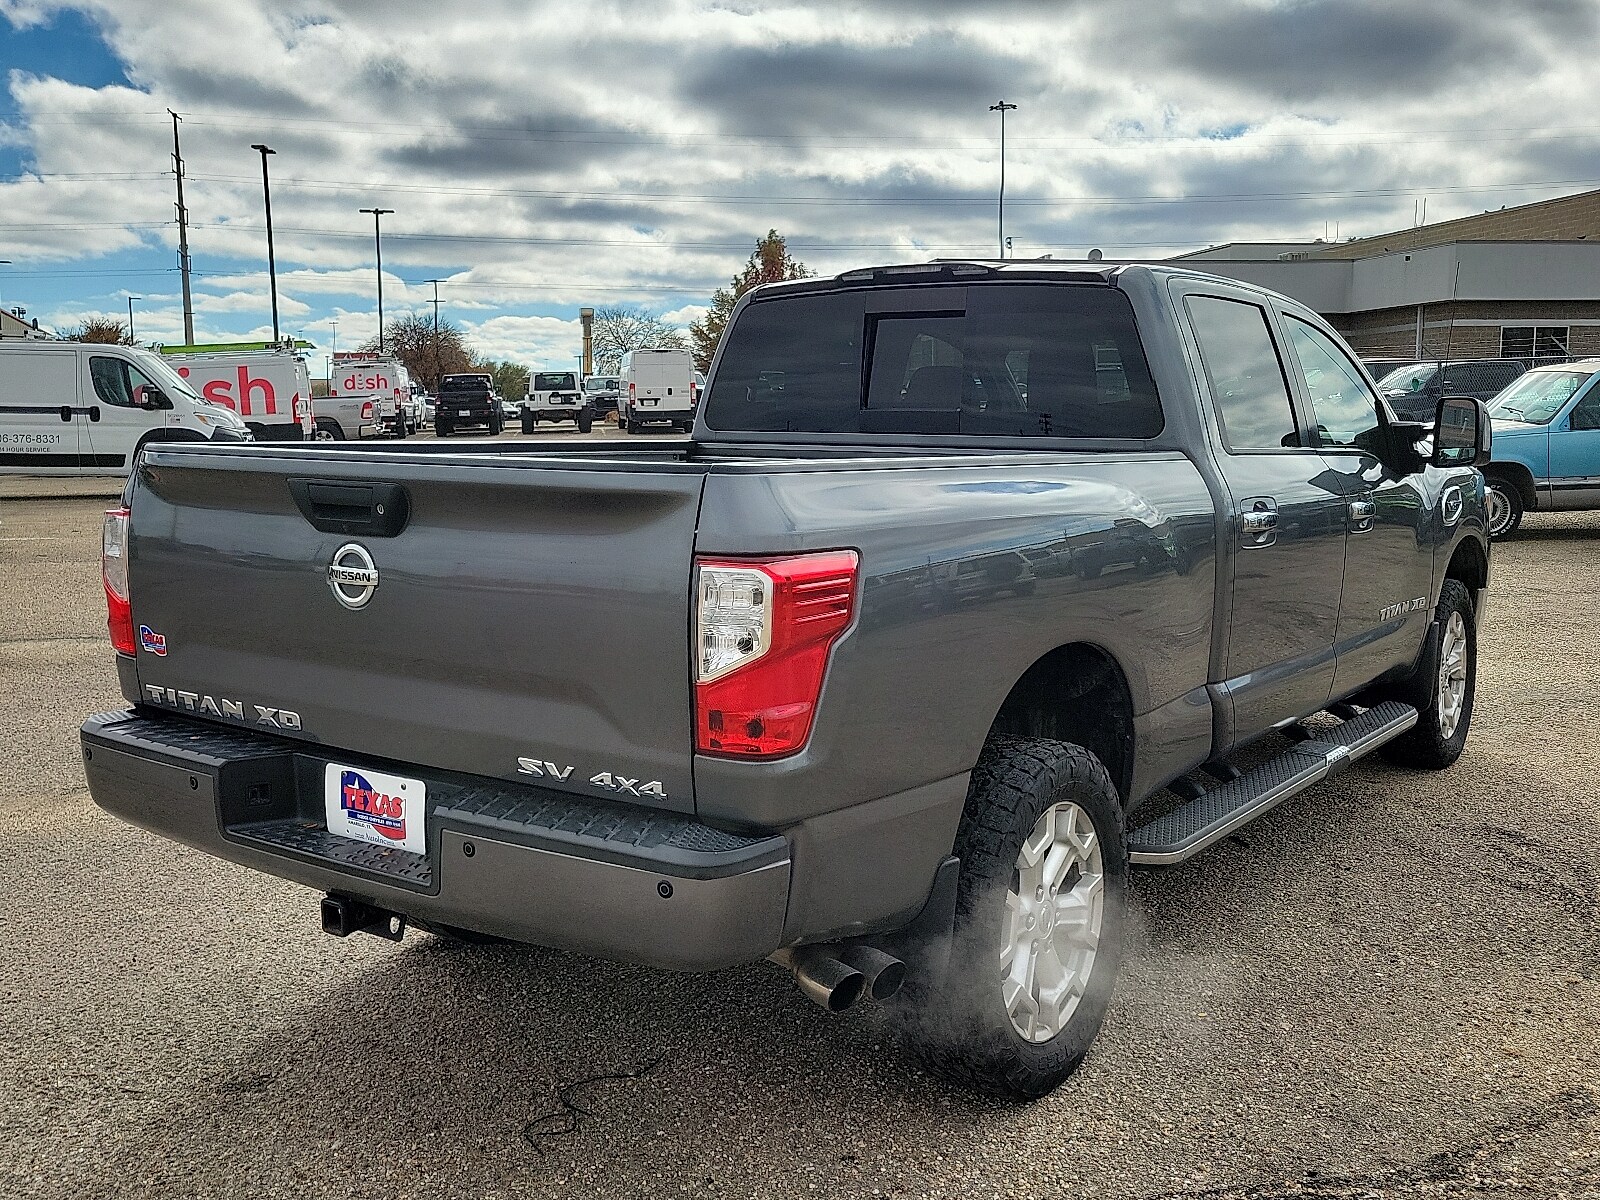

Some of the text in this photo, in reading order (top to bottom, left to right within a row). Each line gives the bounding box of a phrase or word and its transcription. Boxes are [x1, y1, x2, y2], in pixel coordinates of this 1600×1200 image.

[344, 373, 388, 390] dish
[0, 433, 60, 444] 6-376-8331
[329, 567, 371, 583] NISSAN
[1379, 600, 1410, 622] TITAN
[145, 683, 302, 731] TITAN XD
[517, 756, 574, 783] SV
[343, 784, 403, 819] TEXAS
